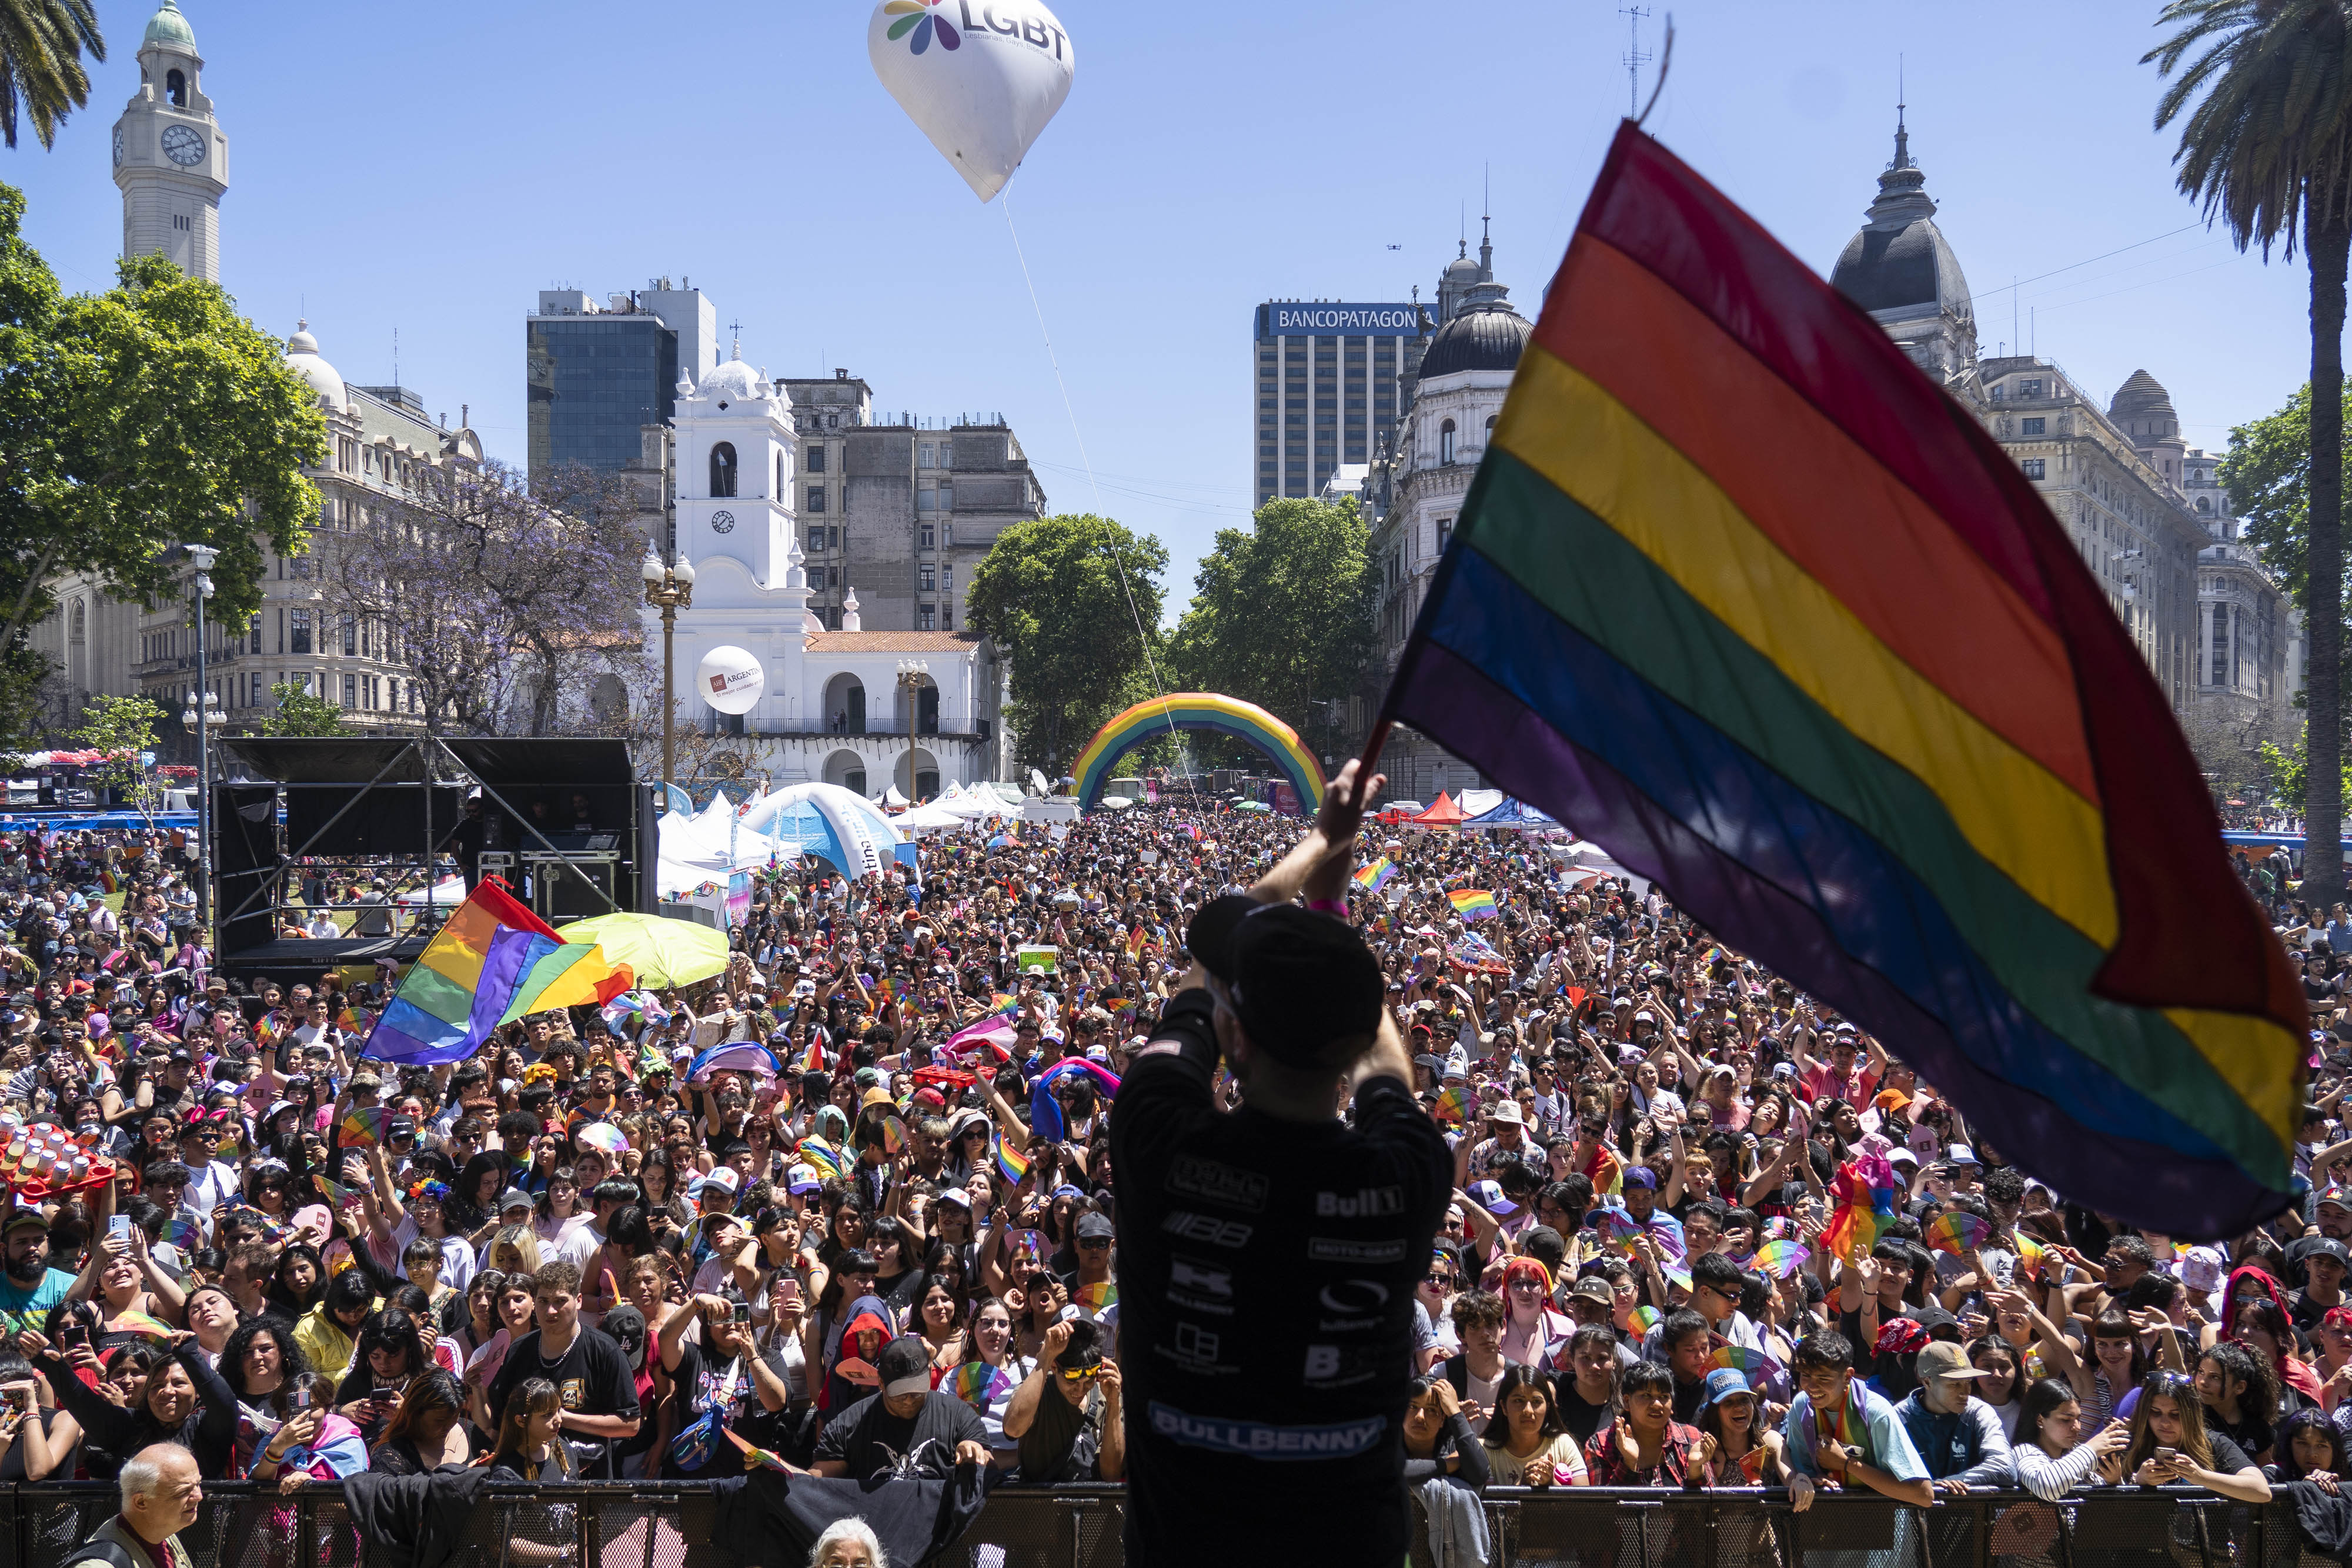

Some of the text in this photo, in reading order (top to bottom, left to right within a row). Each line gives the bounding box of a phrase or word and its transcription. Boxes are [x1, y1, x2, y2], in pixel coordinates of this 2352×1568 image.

[959, 0, 1065, 61] LGBT
[964, 32, 1005, 43] Lesbianas,
[1006, 38, 1025, 49] Gays,
[1026, 44, 1056, 65] Bisexuales
[1279, 310, 1433, 327] BANCOPATAGONA
[713, 678, 723, 687] AHF
[722, 689, 735, 698] mejor
[736, 682, 754, 692] cuidado
[620, 1335, 632, 1350] LA
[1155, 1409, 1383, 1452] BULLBENNY
